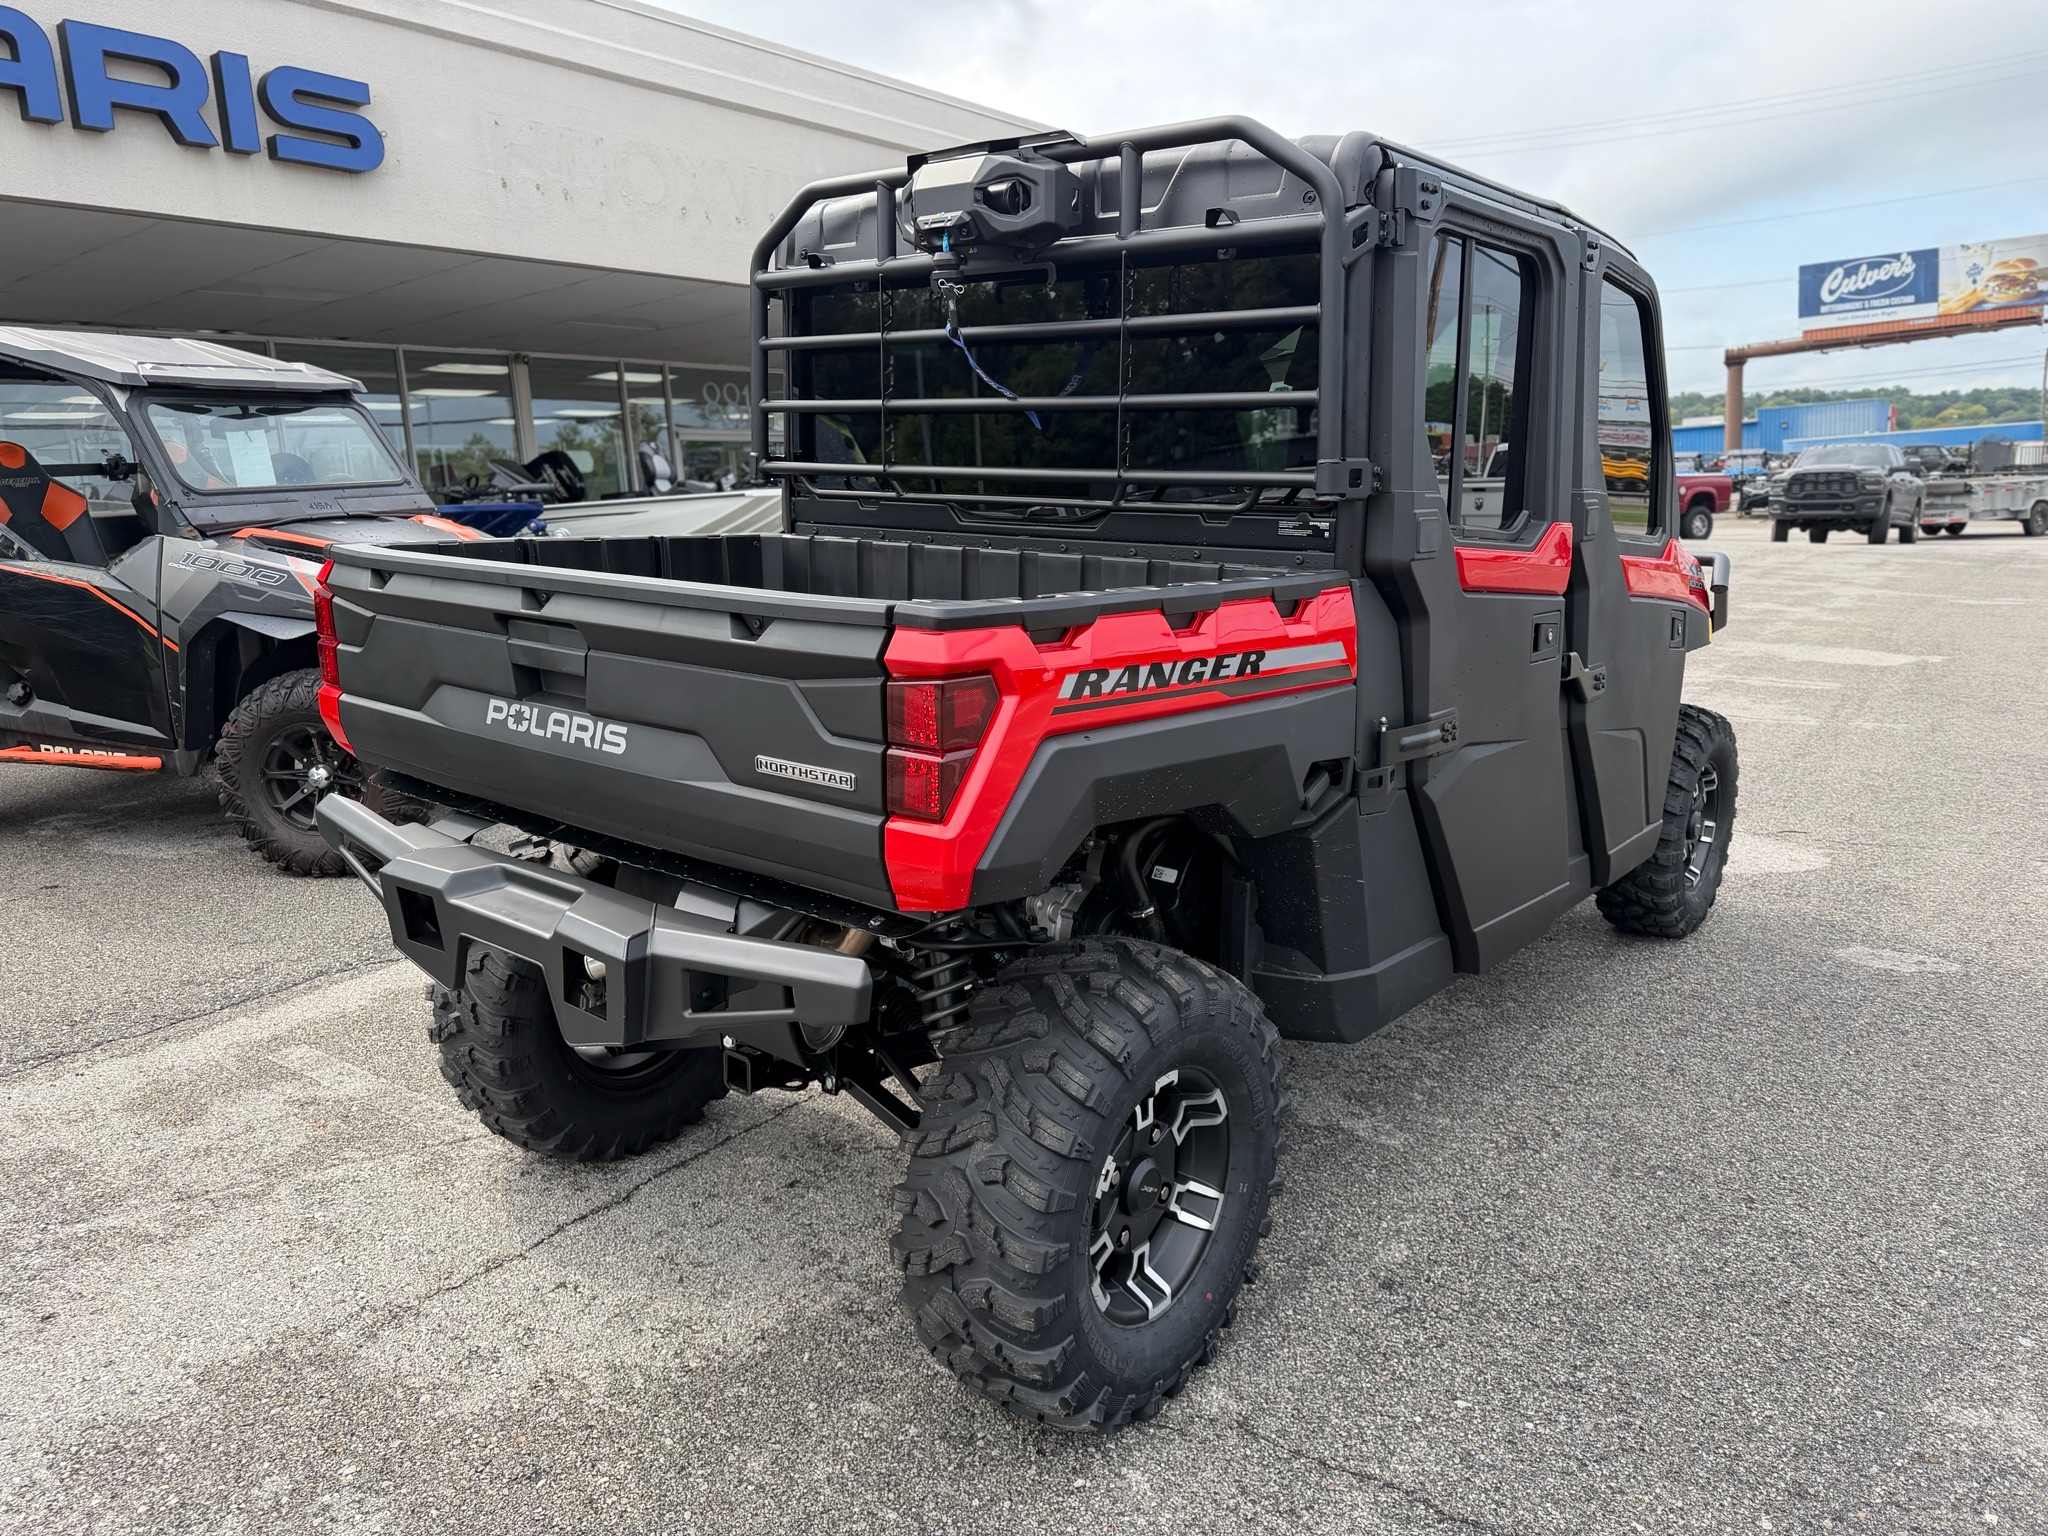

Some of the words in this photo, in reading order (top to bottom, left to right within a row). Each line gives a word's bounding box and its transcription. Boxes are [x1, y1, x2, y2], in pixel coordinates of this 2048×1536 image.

[1820, 252, 1916, 303] Culver's
[167, 561, 197, 572] DOHC
[179, 552, 288, 585] 1000
[1068, 650, 1266, 701] RANGER
[486, 698, 628, 755] POLARIS
[758, 759, 852, 787] NORTHSTAR
